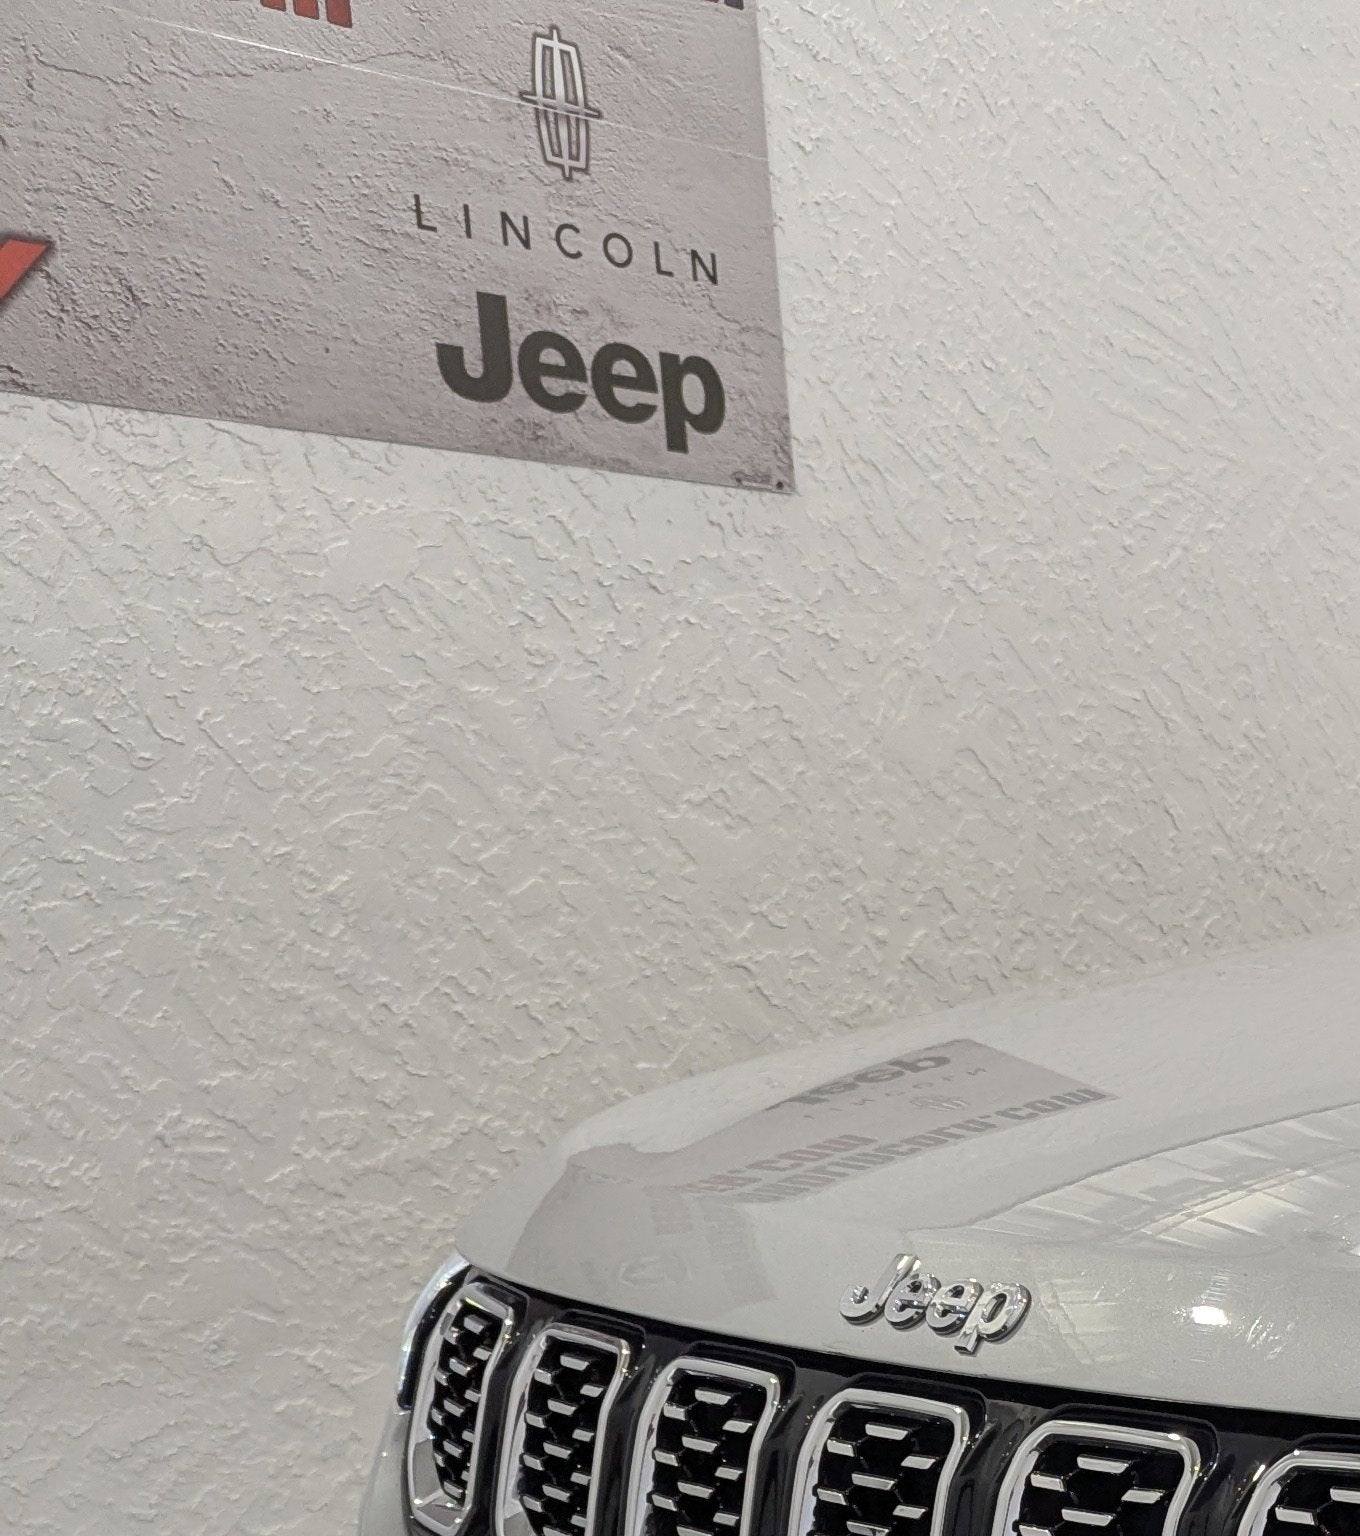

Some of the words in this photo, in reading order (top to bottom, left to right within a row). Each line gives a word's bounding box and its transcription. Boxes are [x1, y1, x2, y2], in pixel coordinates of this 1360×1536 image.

[413, 194, 720, 286] LINCOLN
[435, 289, 726, 453] Jeep
[839, 1253, 1033, 1357] Jeep
